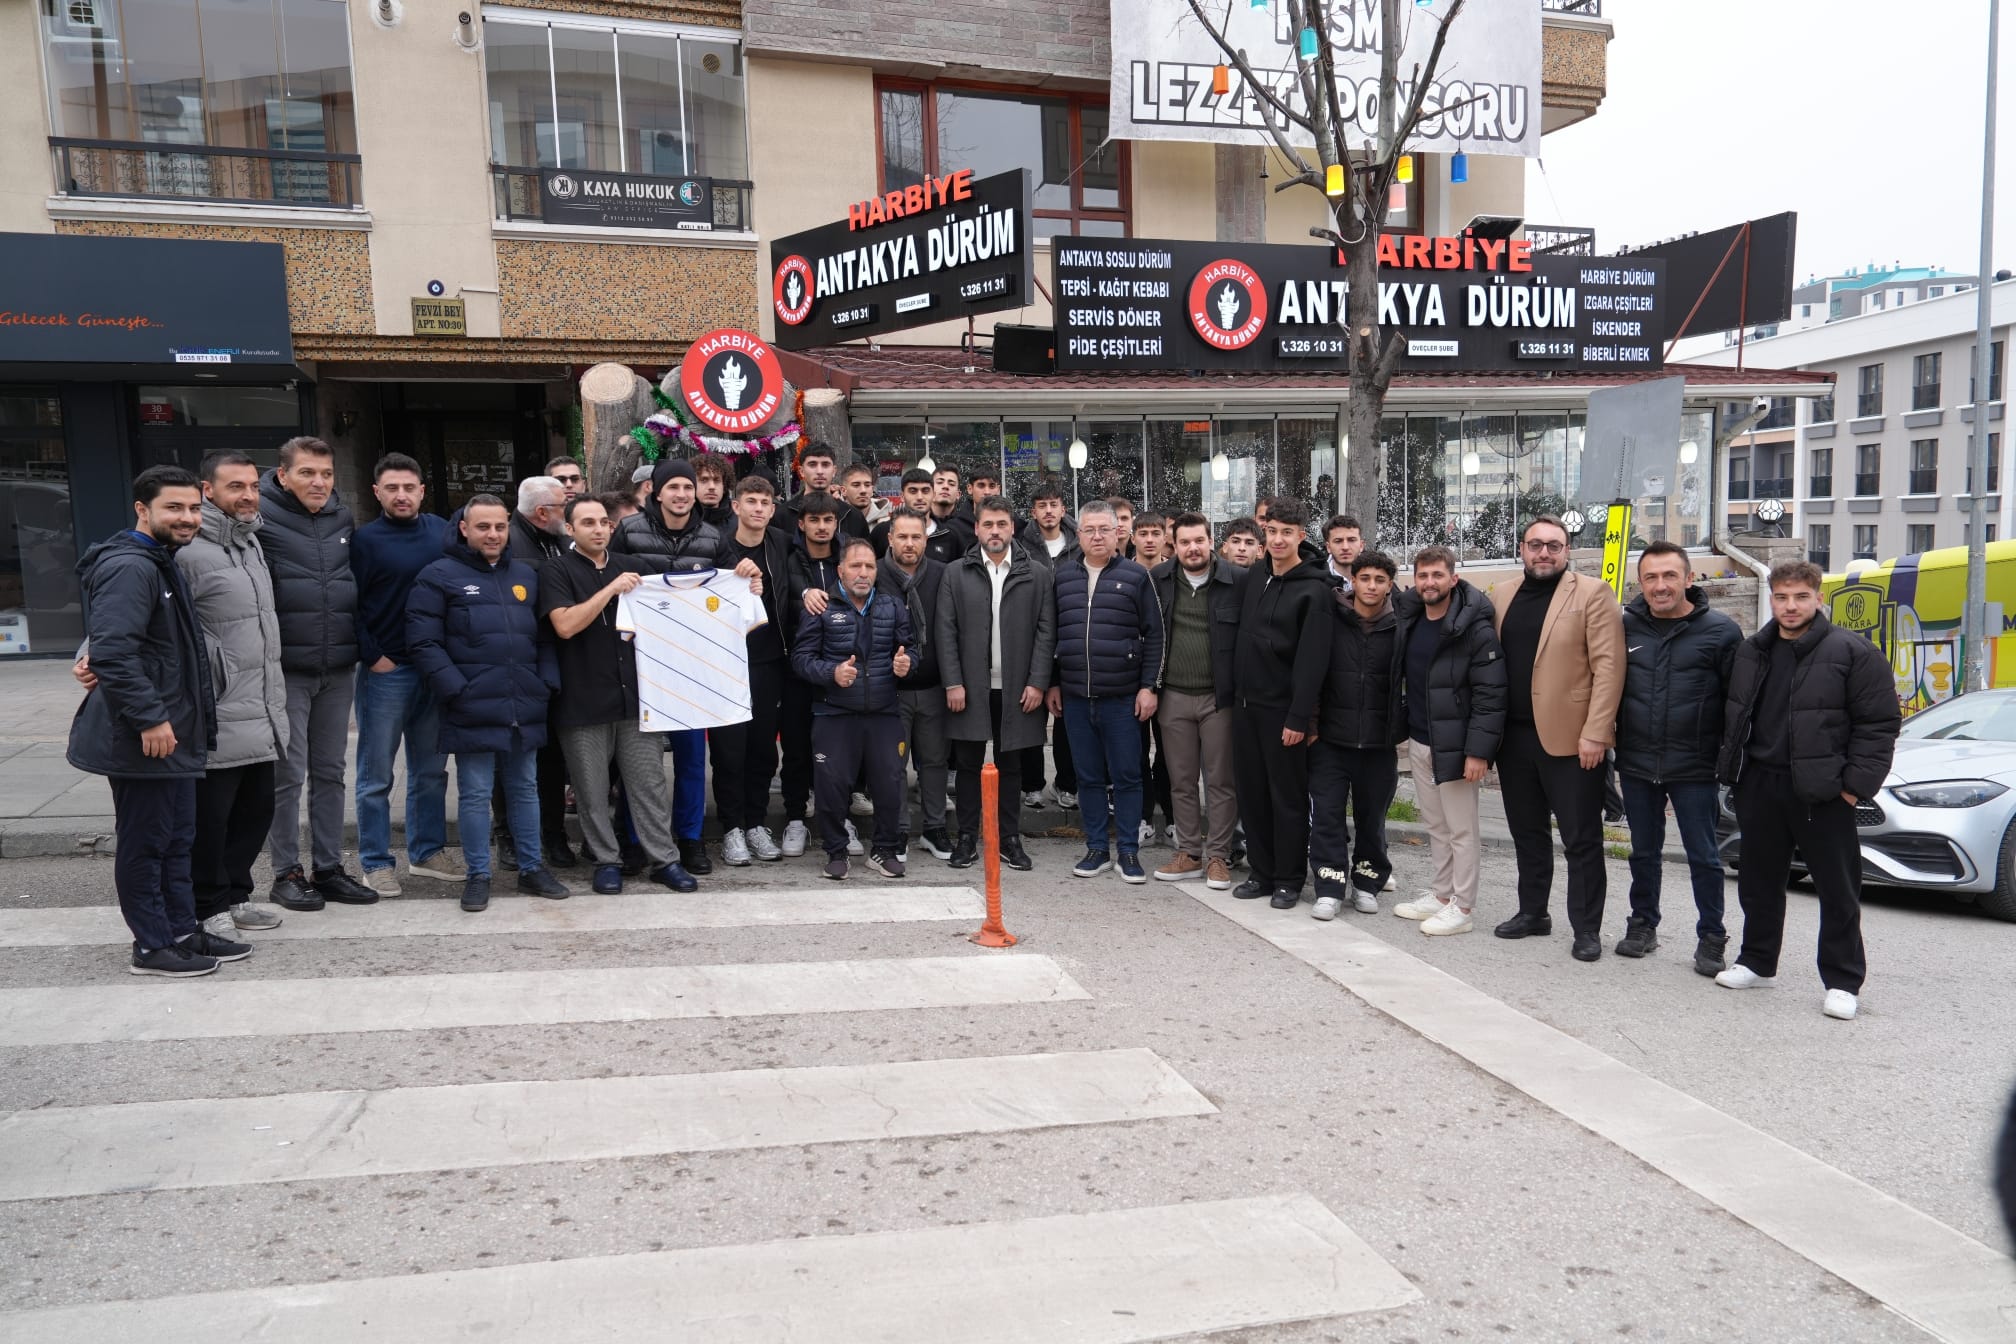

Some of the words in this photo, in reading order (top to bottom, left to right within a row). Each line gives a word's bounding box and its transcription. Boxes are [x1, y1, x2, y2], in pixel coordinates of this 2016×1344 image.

[1130, 60, 1298, 130] LEZZET
[583, 180, 622, 198] KAYA
[626, 183, 676, 200] HUKUK
[848, 168, 975, 232] HARBİYE
[816, 234, 920, 299] ANTAKYA
[927, 204, 1014, 272] DÜRÜM
[1059, 250, 1103, 267] ANTAKYA
[1105, 251, 1136, 269] SOSLU
[1138, 249, 1172, 269] DÜRÜM
[780, 259, 806, 277] HARBİYE
[1204, 264, 1255, 288] HARBİYE
[1580, 267, 1620, 284] HARBİYE
[1622, 268, 1655, 286] DÜRÜM
[966, 282, 982, 296] 326
[983, 280, 992, 293] 11
[995, 278, 1004, 290] 31
[1060, 276, 1090, 297] TEPSİ
[1099, 277, 1130, 298] KAĞIT
[1132, 281, 1170, 298] KEBABI
[415, 302, 442, 317] FEVZİ
[444, 305, 461, 317] BEY
[1278, 280, 1446, 326] ANTKYA
[1467, 275, 1576, 328] DÜRÜM
[1584, 295, 1613, 310] IZGARA
[1614, 293, 1653, 314] ÇEŞİTLERİ
[0, 311, 71, 326] Gelecek
[417, 320, 436, 329] APT.
[438, 320, 462, 330] NO:30
[837, 312, 849, 323] 326
[851, 309, 858, 320] 10
[860, 307, 868, 318] 31
[1068, 306, 1114, 327] SERVİS
[1118, 307, 1162, 327] DÖNER
[1194, 312, 1231, 346] ANTAKYA
[1232, 316, 1262, 346] DÜRÜM
[1592, 318, 1641, 336] İSKENDER
[699, 335, 766, 360] HARBİYE
[1069, 336, 1098, 356] PİDE
[1100, 336, 1162, 360] ÇEŞİTLERİ
[1289, 341, 1310, 353] 326
[1313, 341, 1327, 353] 10
[1330, 341, 1343, 353] 31
[1527, 343, 1546, 354] 326
[1548, 344, 1560, 354] 11
[1562, 344, 1574, 354] 31
[1583, 344, 1617, 361] BİBERLİ
[1619, 348, 1650, 362] EKMEK
[688, 390, 738, 428] ANTAKYA
[740, 393, 777, 427] DÜRÜM
[1848, 596, 1864, 621] MKE
[1837, 618, 1872, 630] ANKARA
